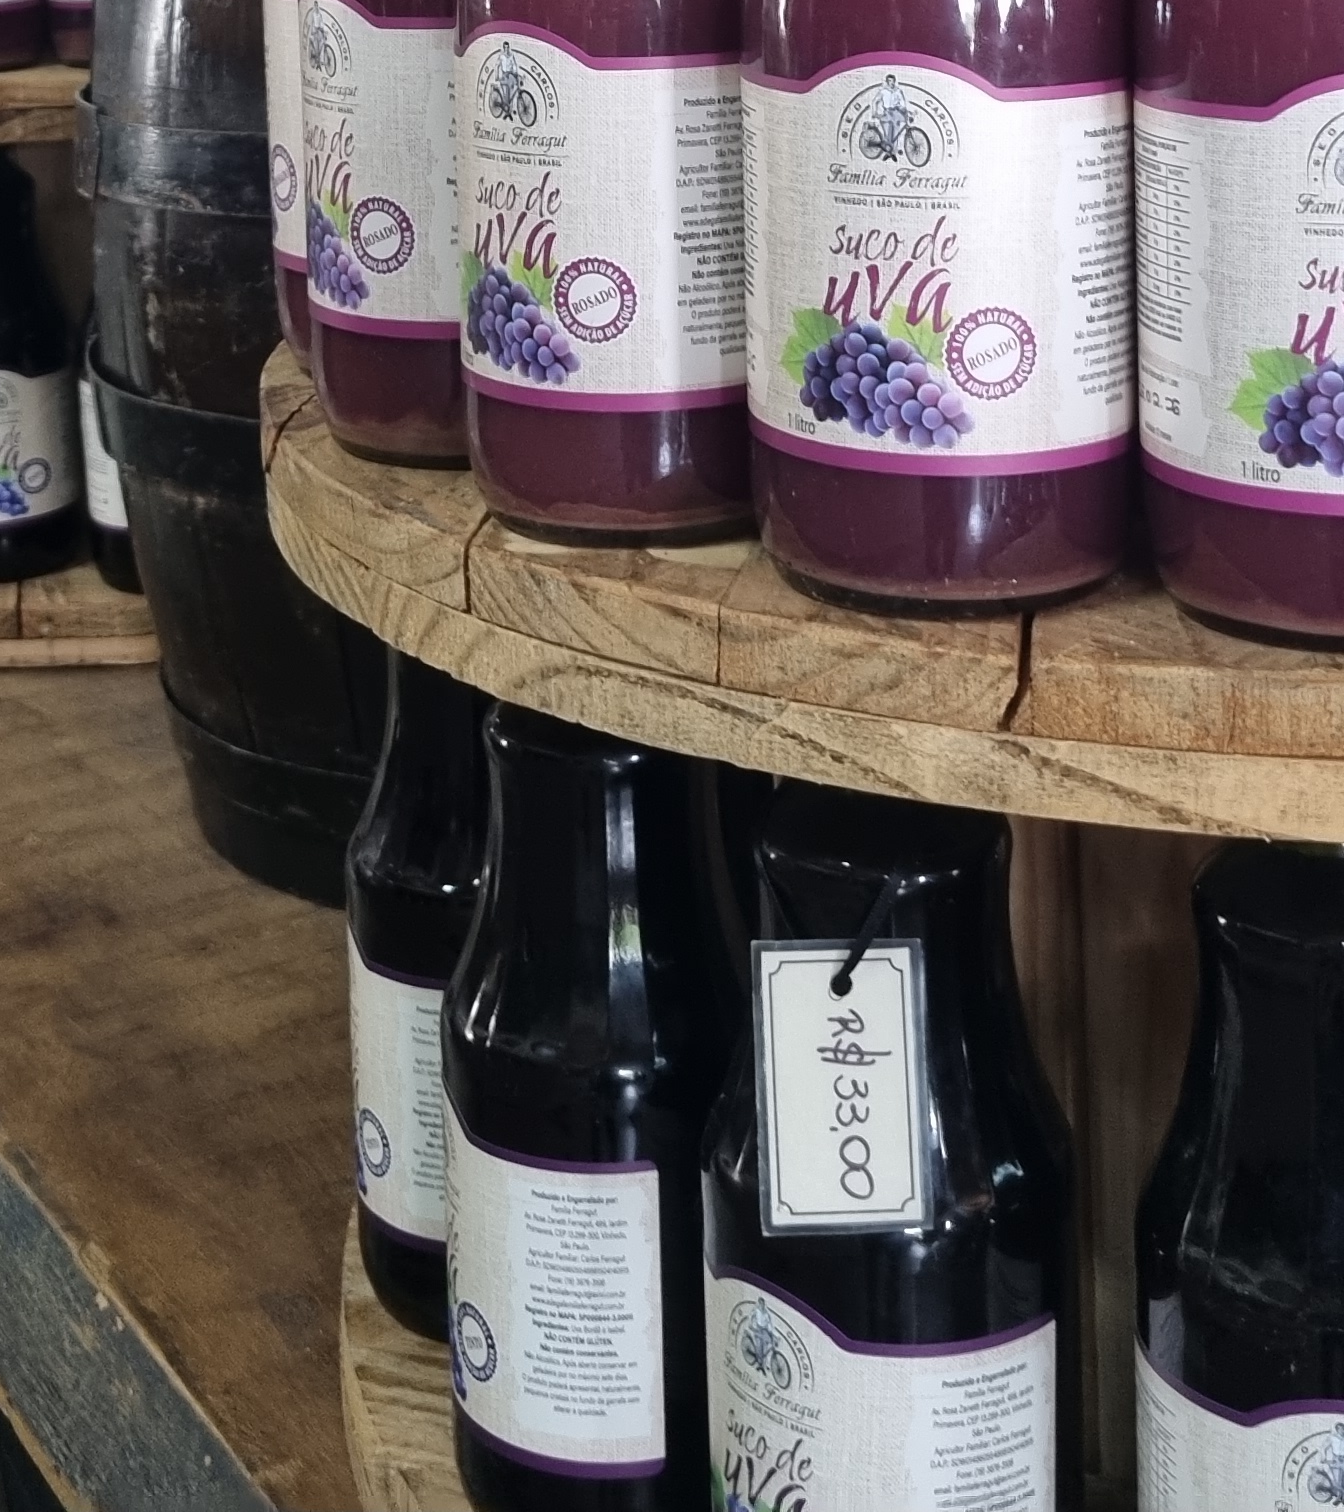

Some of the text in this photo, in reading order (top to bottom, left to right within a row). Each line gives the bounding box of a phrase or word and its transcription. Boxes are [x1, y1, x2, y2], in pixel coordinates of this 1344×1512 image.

[530, 65, 555, 109] CARLOS
[330, 117, 356, 160] de
[510, 126, 568, 154] Ferragut
[924, 99, 955, 146] CARLOS
[305, 152, 354, 215] uva
[475, 170, 563, 218] suco de
[827, 163, 968, 195] Família Ferragut
[876, 197, 893, 208] SÃO
[895, 199, 922, 209] PAULO
[362, 223, 399, 248] ROSADO
[474, 211, 559, 280] uva
[830, 215, 960, 268] suco de
[1303, 227, 1344, 237] VINHEDO
[558, 261, 635, 341] 100% NATURAL SEM ADIÇÃO DE AÇÚCAR
[571, 286, 619, 316] ROSADO
[823, 261, 953, 334] uva
[951, 310, 1034, 399] 100% NATURAL SEM ADIÇÃO DE AÇÚCAR
[967, 337, 1018, 371] ROSADO
[794, 413, 817, 436] litro
[1252, 460, 1281, 484] litro
[762, 1383, 822, 1421] Ferragut
[725, 1409, 814, 1482] suco de
